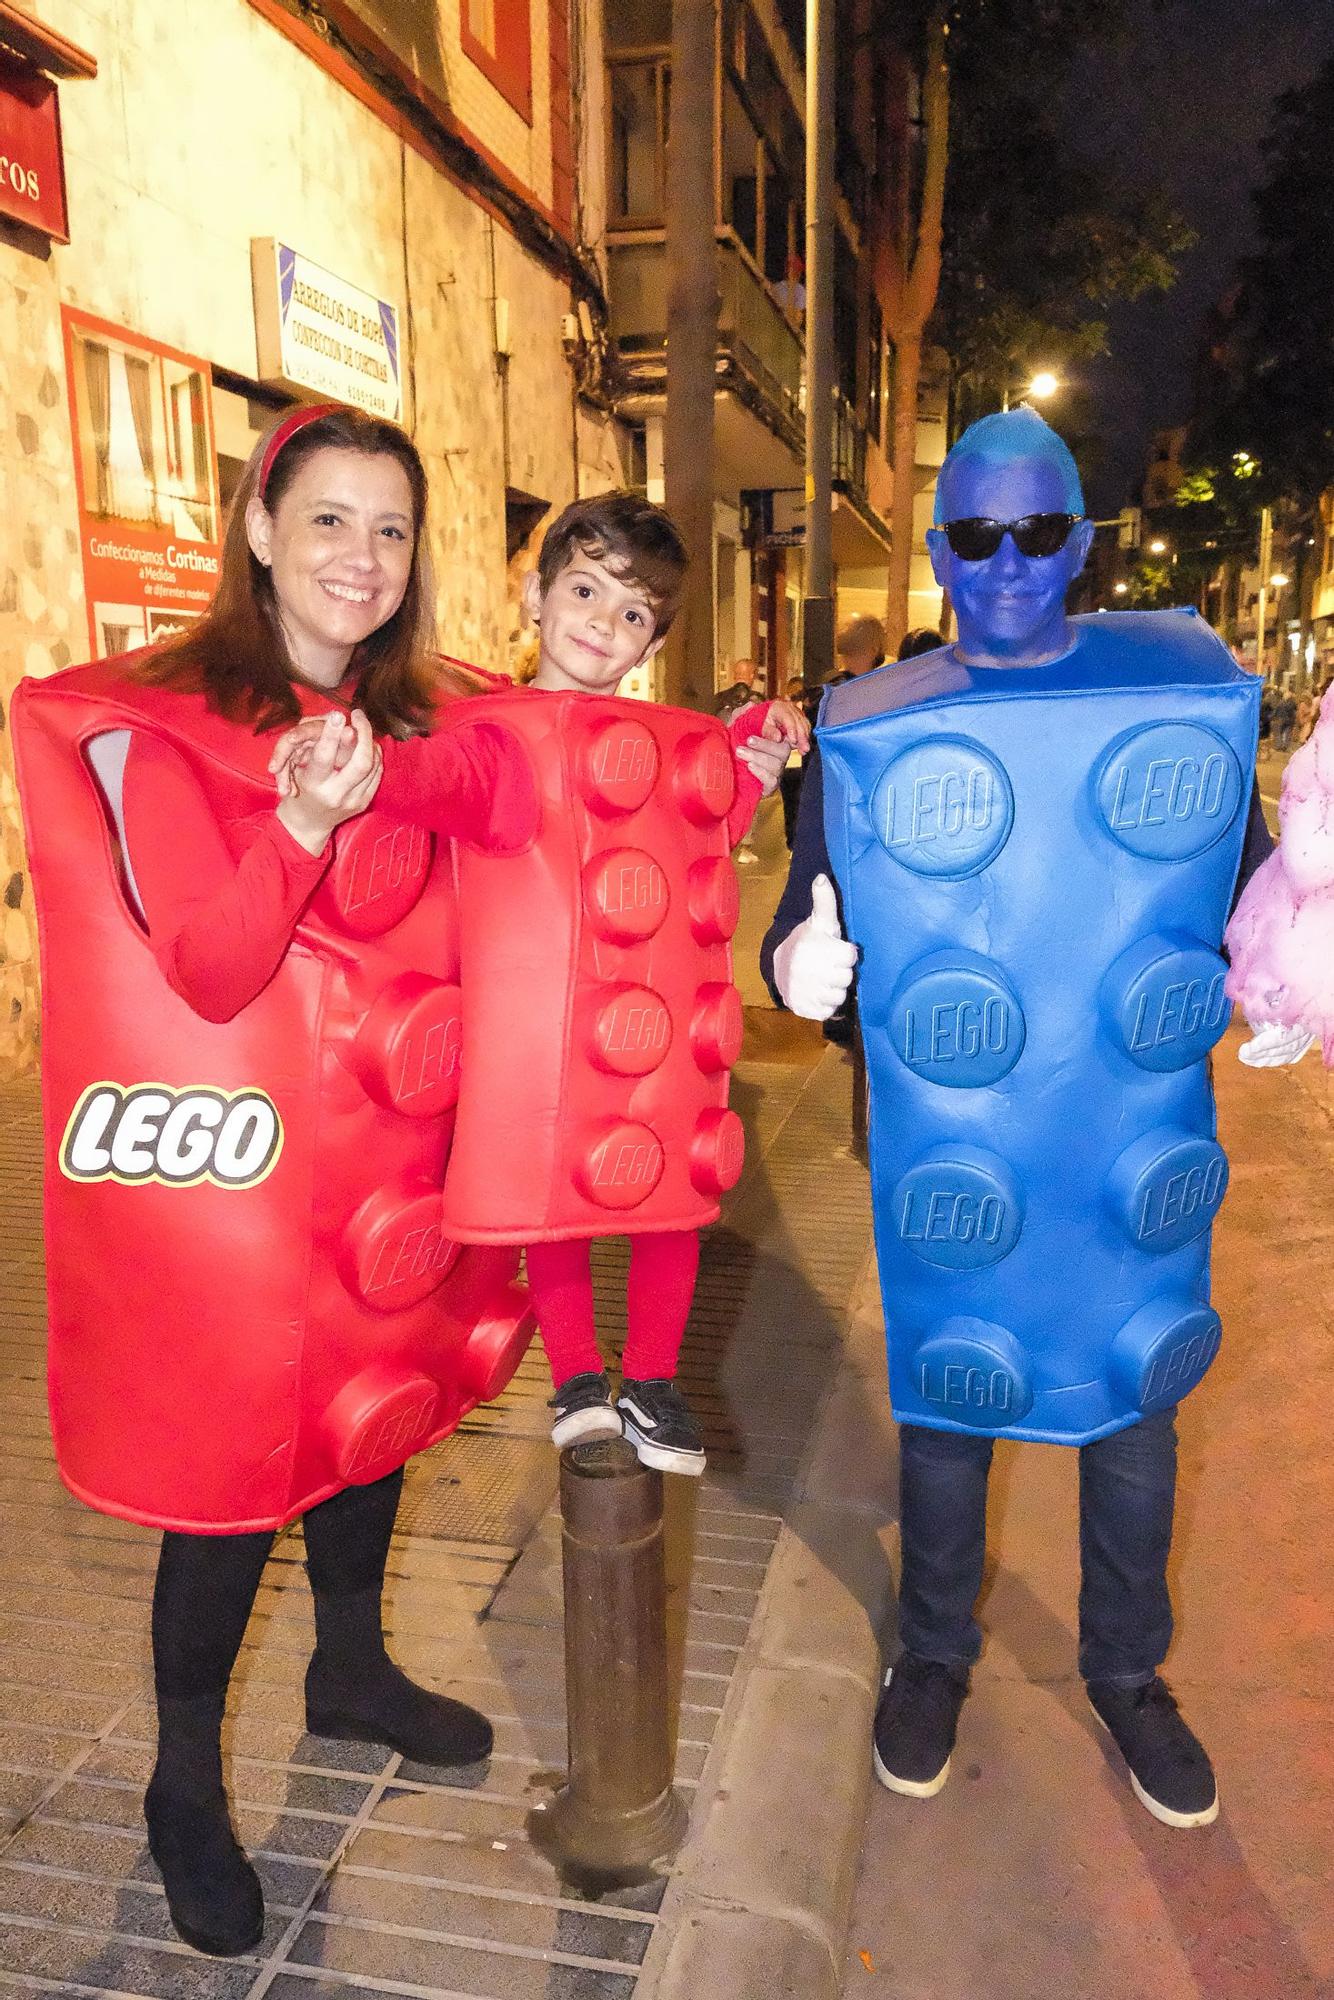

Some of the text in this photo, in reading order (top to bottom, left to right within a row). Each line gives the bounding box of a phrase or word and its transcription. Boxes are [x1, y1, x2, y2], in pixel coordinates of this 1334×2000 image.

[292, 279, 385, 346] ARREGLOS DE ROPA
[292, 320, 341, 362] CONFECCION
[344, 345, 354, 367] DE
[355, 350, 388, 383] CORTINAS
[90, 537, 218, 574] Confeccionamos Cortinas
[139, 566, 144, 579] a
[144, 583, 152, 595] de
[153, 583, 185, 599] diferentes
[598, 737, 656, 784] LEGO
[1110, 752, 1229, 831] LEGO
[884, 765, 994, 849] LEGO
[343, 823, 426, 915] LEGO
[603, 863, 661, 914] LEGO
[605, 1008, 668, 1052] LEGO
[905, 994, 1009, 1066] LEGO
[1129, 972, 1228, 1053] LEGO
[394, 1017, 462, 1103] LEG
[65, 1087, 279, 1184] LEGO
[593, 1143, 661, 1186] LEGO
[900, 1189, 1006, 1246] LEGO
[1137, 1156, 1226, 1242] LEGO
[363, 1223, 454, 1294] LEGO
[919, 1362, 1014, 1411] LEGO
[1140, 1323, 1219, 1407] LEGO
[345, 1394, 439, 1478] LEGO
